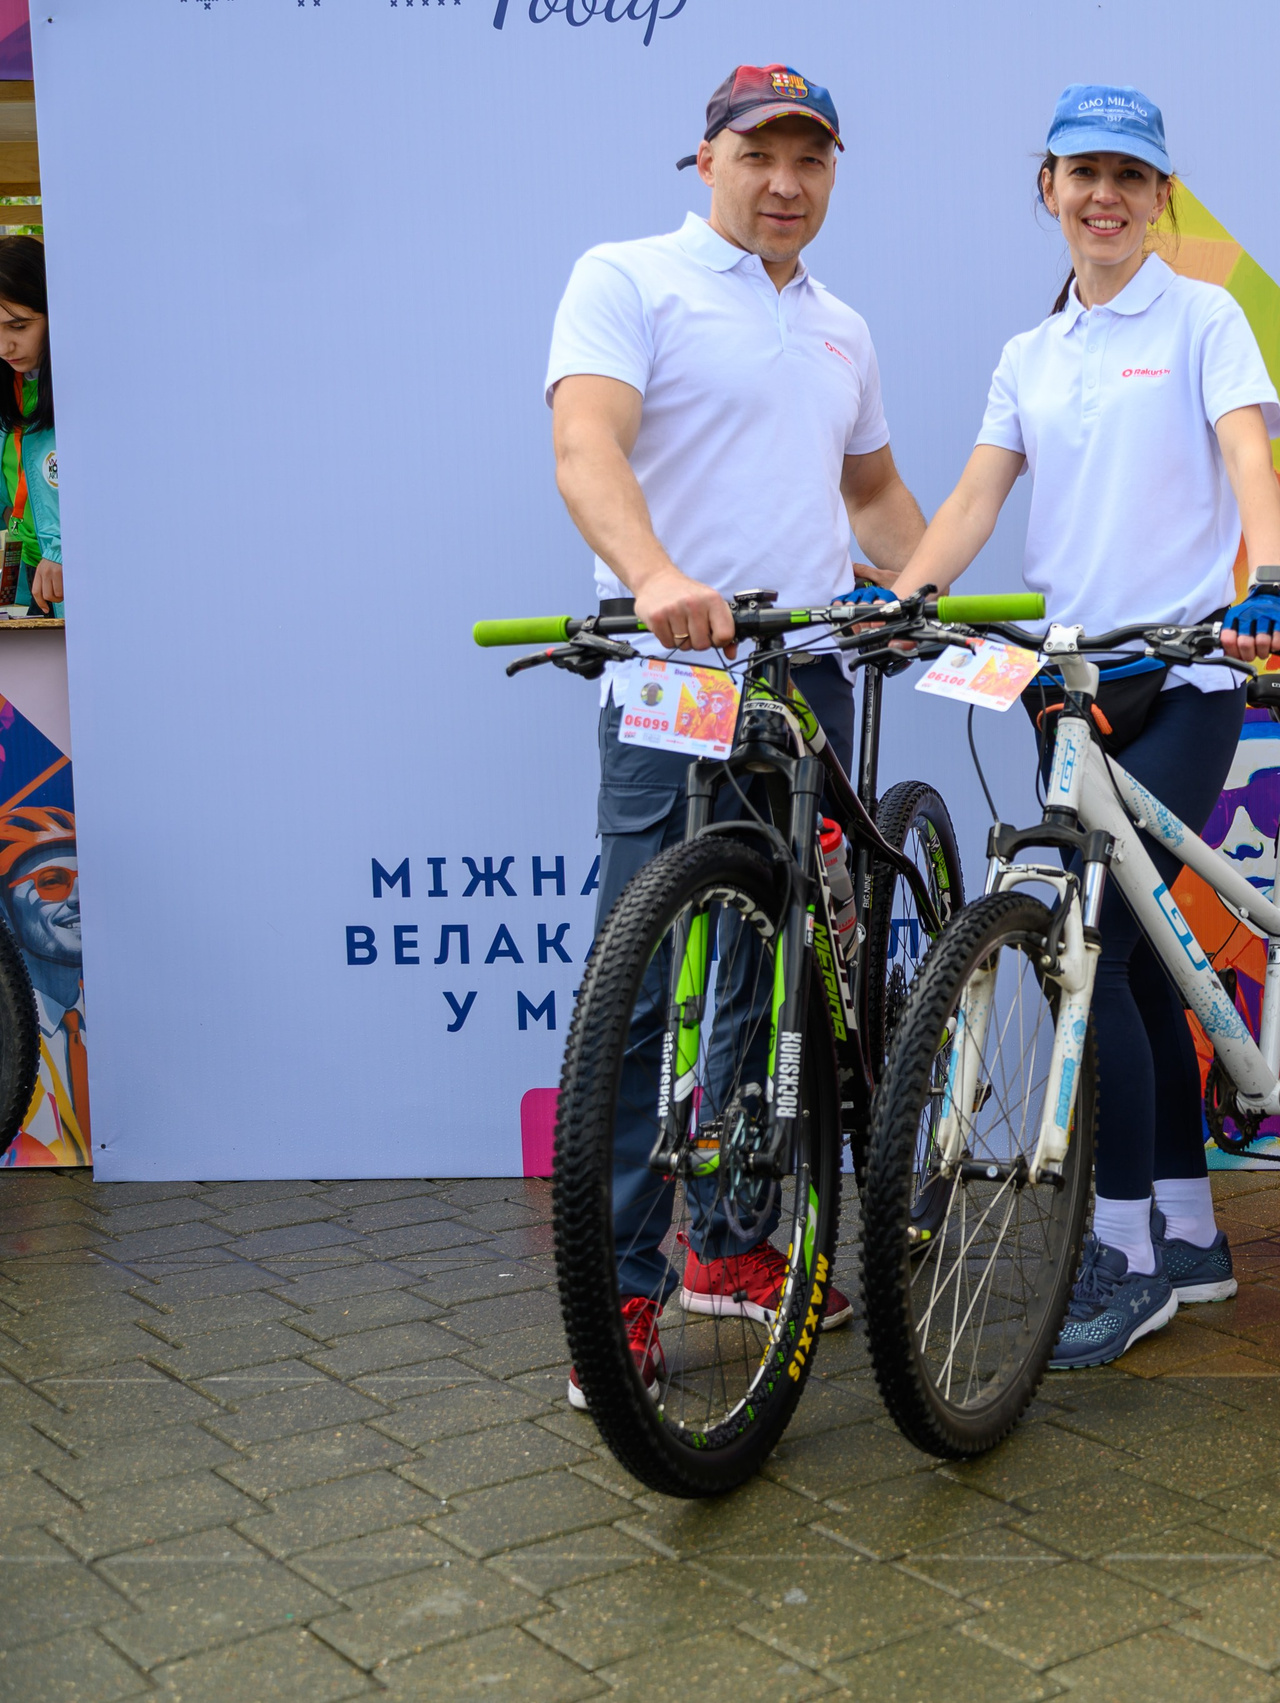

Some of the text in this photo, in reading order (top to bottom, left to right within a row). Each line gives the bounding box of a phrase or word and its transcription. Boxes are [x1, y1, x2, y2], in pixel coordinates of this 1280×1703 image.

[1078, 96, 1148, 118] CIAO MILANO
[927, 671, 966, 686] 06100
[624, 714, 670, 732] 06099
[345, 923, 596, 966] ВЕЛАК
[812, 921, 848, 1042] MERIDA
[442, 991, 478, 1032] У
[776, 1031, 802, 1118] ROCKSHOX
[788, 1252, 829, 1382] MAXXIS
